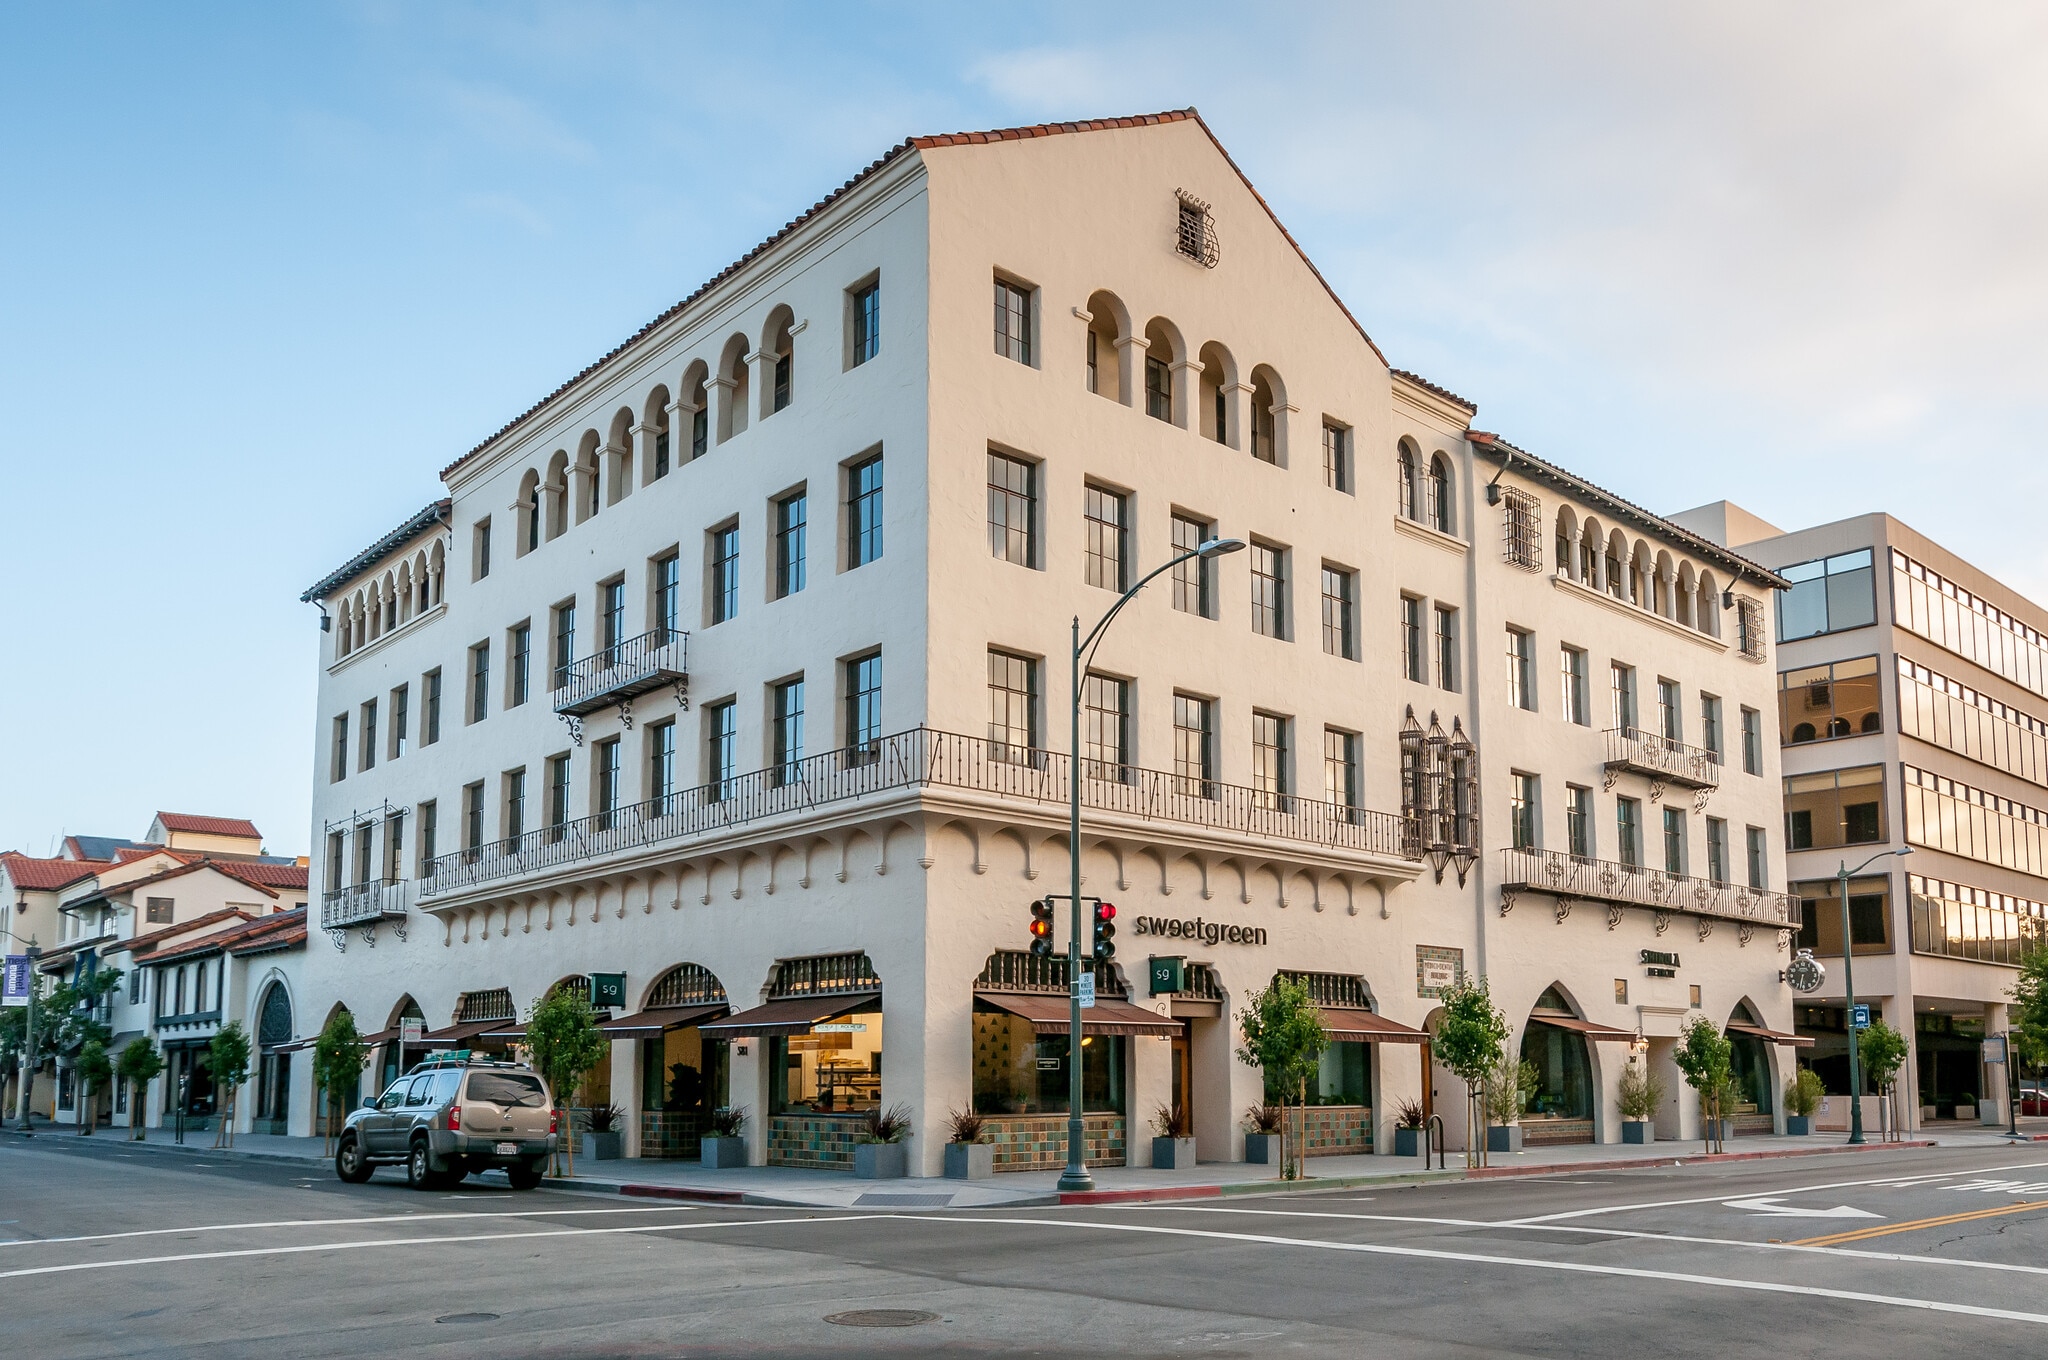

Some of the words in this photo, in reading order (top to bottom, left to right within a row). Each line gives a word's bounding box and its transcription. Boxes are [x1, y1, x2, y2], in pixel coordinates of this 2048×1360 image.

[1136, 915, 1267, 946] sweetgreen
[8, 964, 17, 994] ramona
[16, 964, 26, 990] street
[1156, 969, 1170, 981] sg
[602, 984, 617, 995] sg
